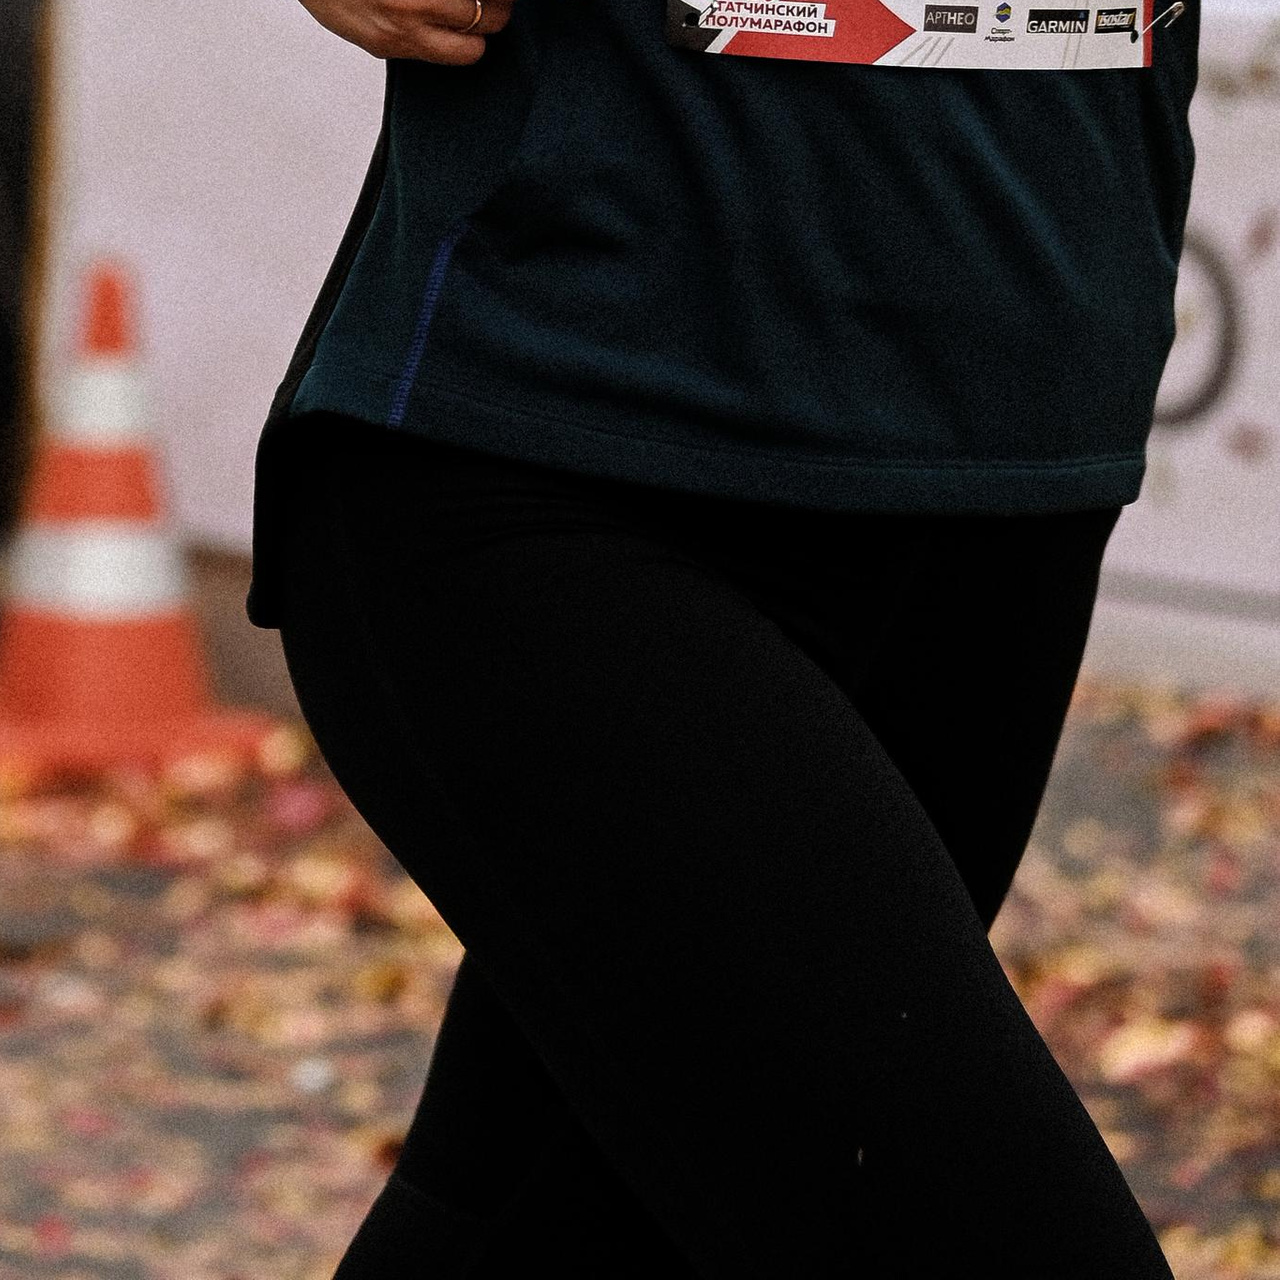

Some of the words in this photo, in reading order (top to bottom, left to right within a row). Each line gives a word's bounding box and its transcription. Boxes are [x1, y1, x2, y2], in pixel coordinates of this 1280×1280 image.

[717, 1, 818, 18] ГАТЧИНСКИЙ
[706, 14, 828, 34] ПОЛУМАРАФОН
[1028, 20, 1087, 33] GARMIN
